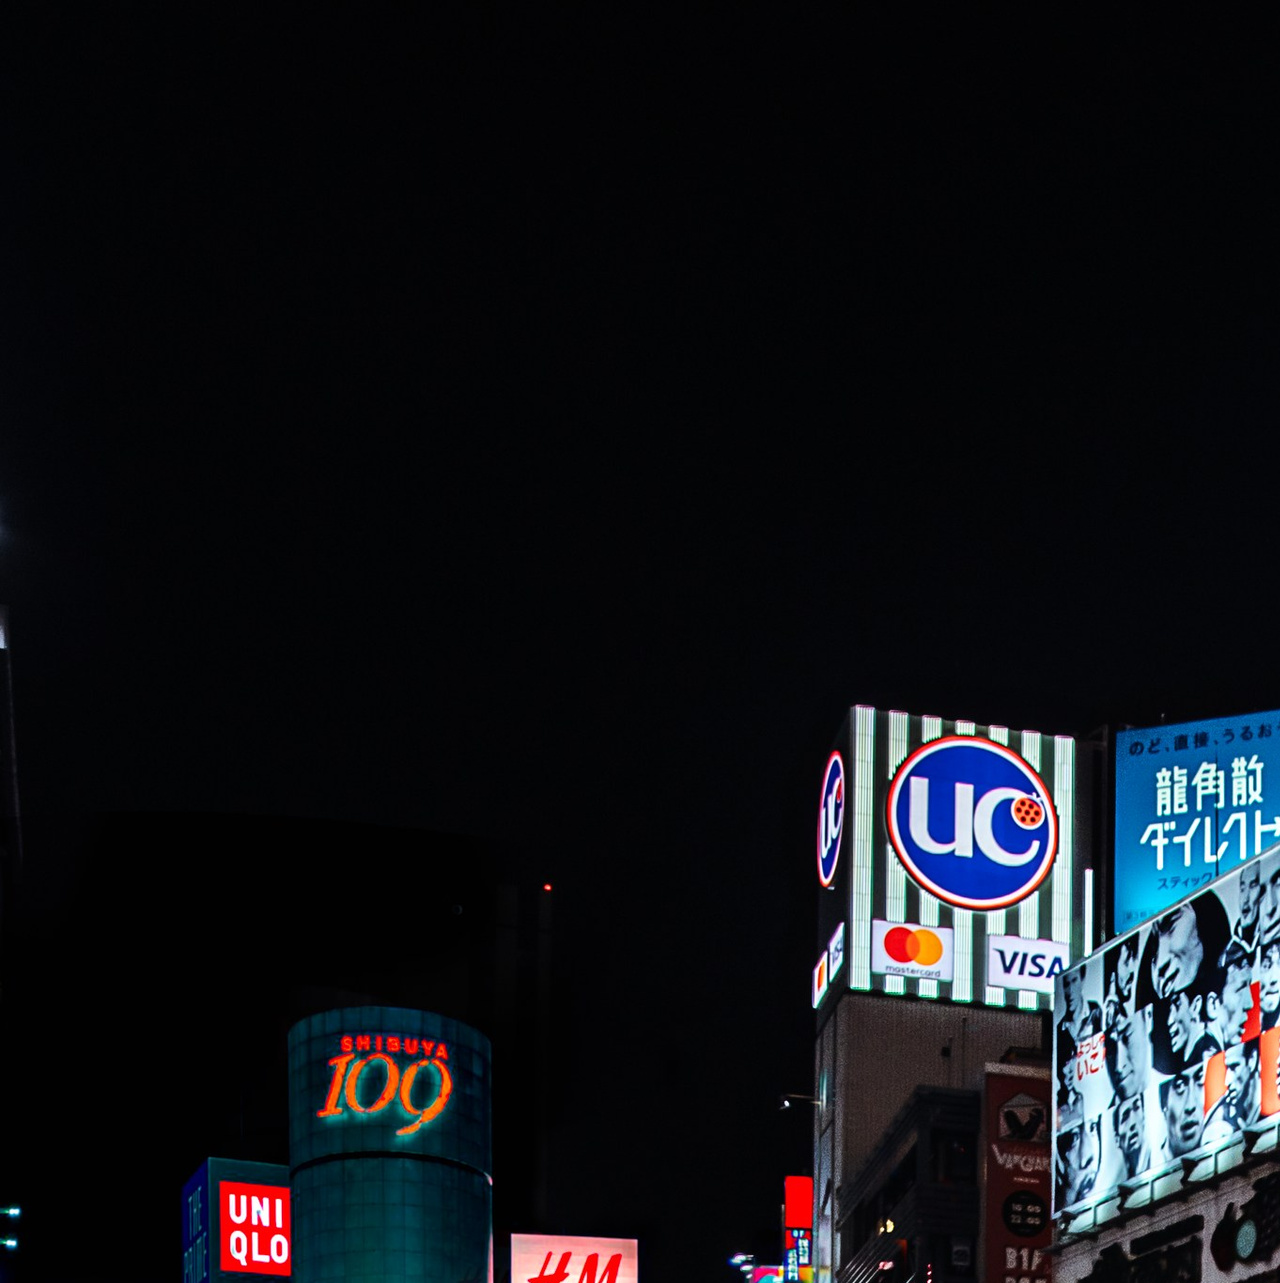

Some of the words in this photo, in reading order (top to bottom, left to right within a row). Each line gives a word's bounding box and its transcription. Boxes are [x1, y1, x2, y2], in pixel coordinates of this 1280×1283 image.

[1156, 754, 1264, 816] 龍角散
[885, 964, 941, 977] mastercard
[993, 948, 1064, 978] VISA
[340, 1034, 448, 1059] SHIBUYA
[316, 1052, 452, 1135] 109
[229, 1194, 283, 1228] UNI
[230, 1231, 288, 1266] QLO
[1005, 1246, 1043, 1271] B1F
